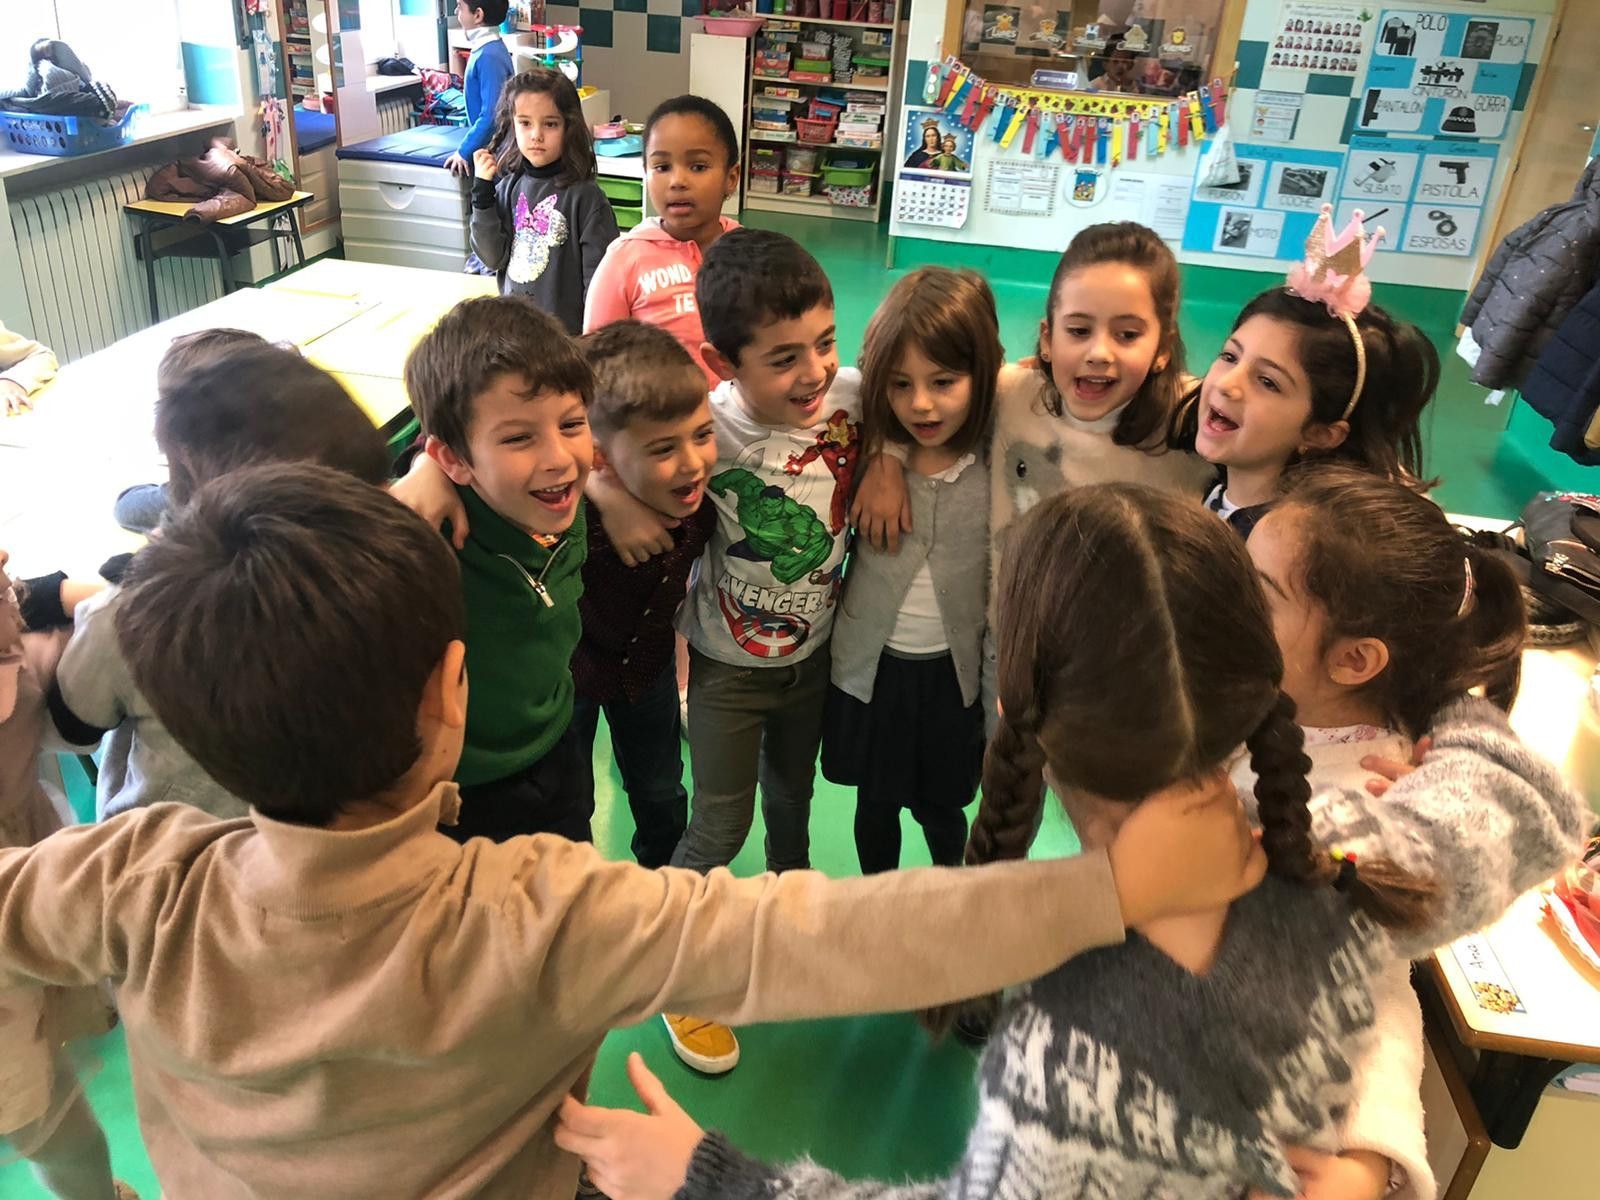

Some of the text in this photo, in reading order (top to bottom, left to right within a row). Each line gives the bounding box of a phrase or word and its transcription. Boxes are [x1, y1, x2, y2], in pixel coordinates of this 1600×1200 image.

[1416, 13, 1447, 32] POLO
[1495, 34, 1525, 48] PLACA
[1473, 95, 1507, 112] GORRA
[1420, 183, 1479, 199] PISTOLA
[1280, 195, 1315, 209] COCHE
[1409, 234, 1468, 250] ESPOSAS
[672, 292, 695, 314] TE
